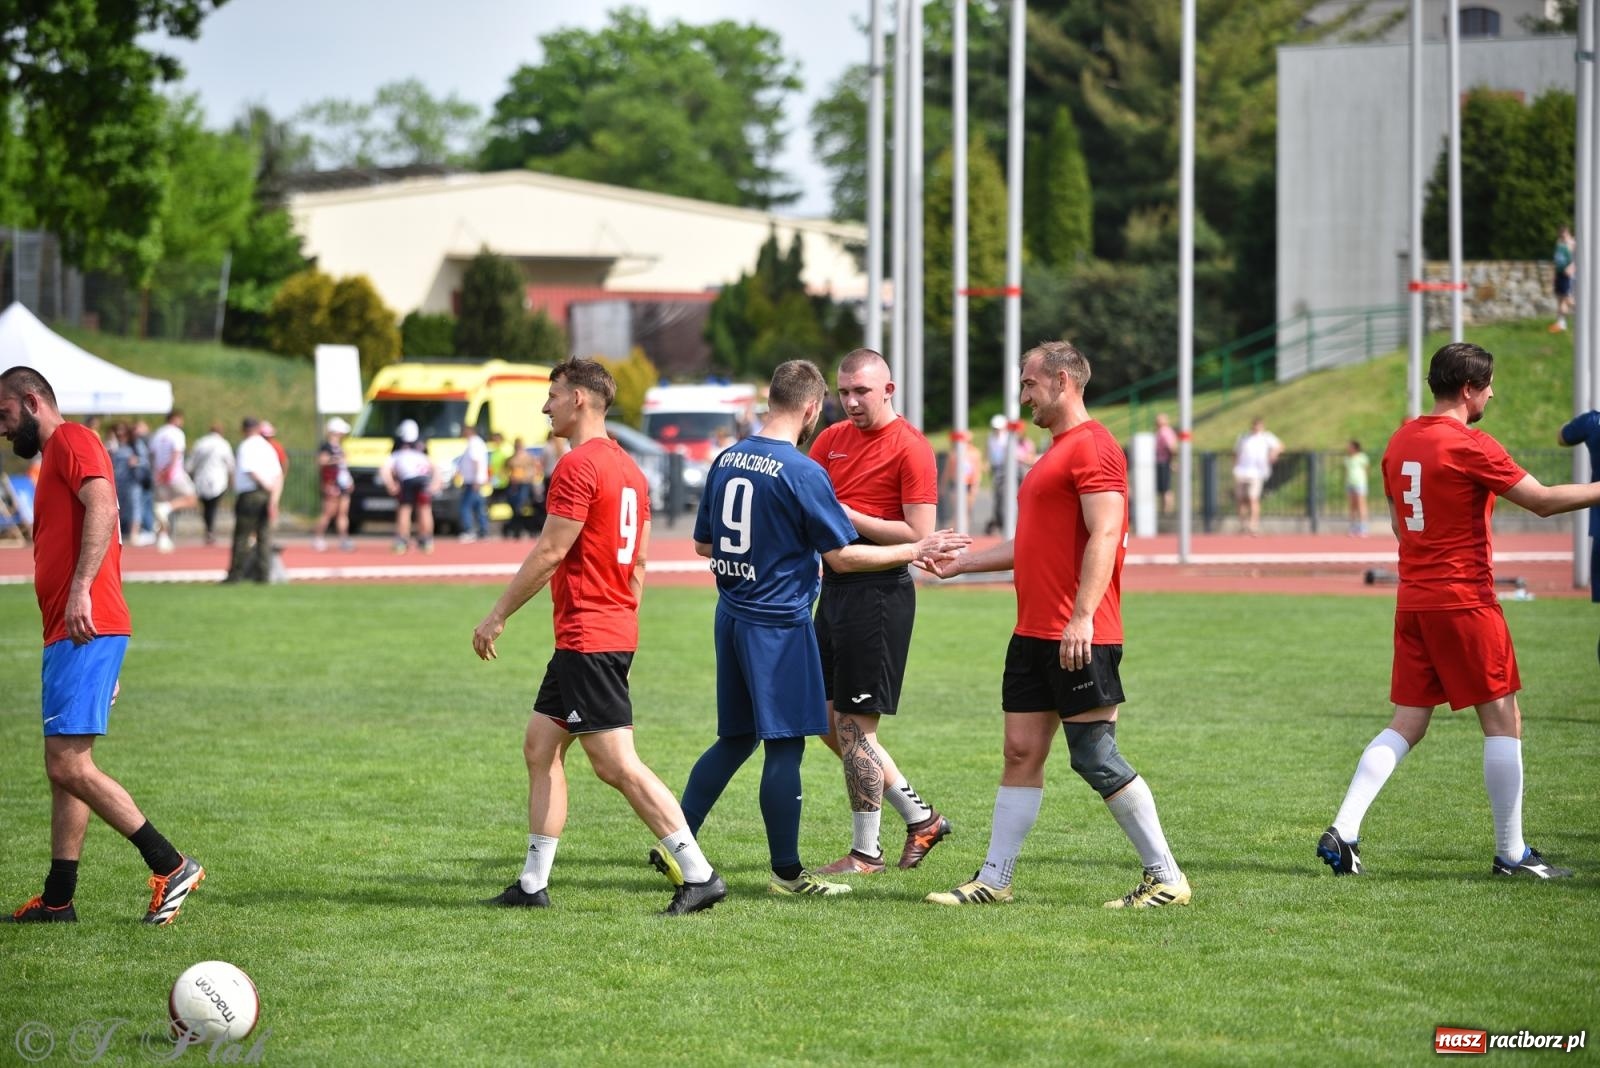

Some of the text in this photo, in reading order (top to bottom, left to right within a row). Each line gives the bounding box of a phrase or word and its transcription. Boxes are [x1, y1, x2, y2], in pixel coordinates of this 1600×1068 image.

[718, 452, 784, 478] KPP RACIBÓRZ
[617, 487, 638, 565] 9
[720, 477, 754, 555] 9
[1401, 461, 1425, 532] 3
[710, 557, 757, 582] POLICA
[195, 977, 236, 1024] macron
